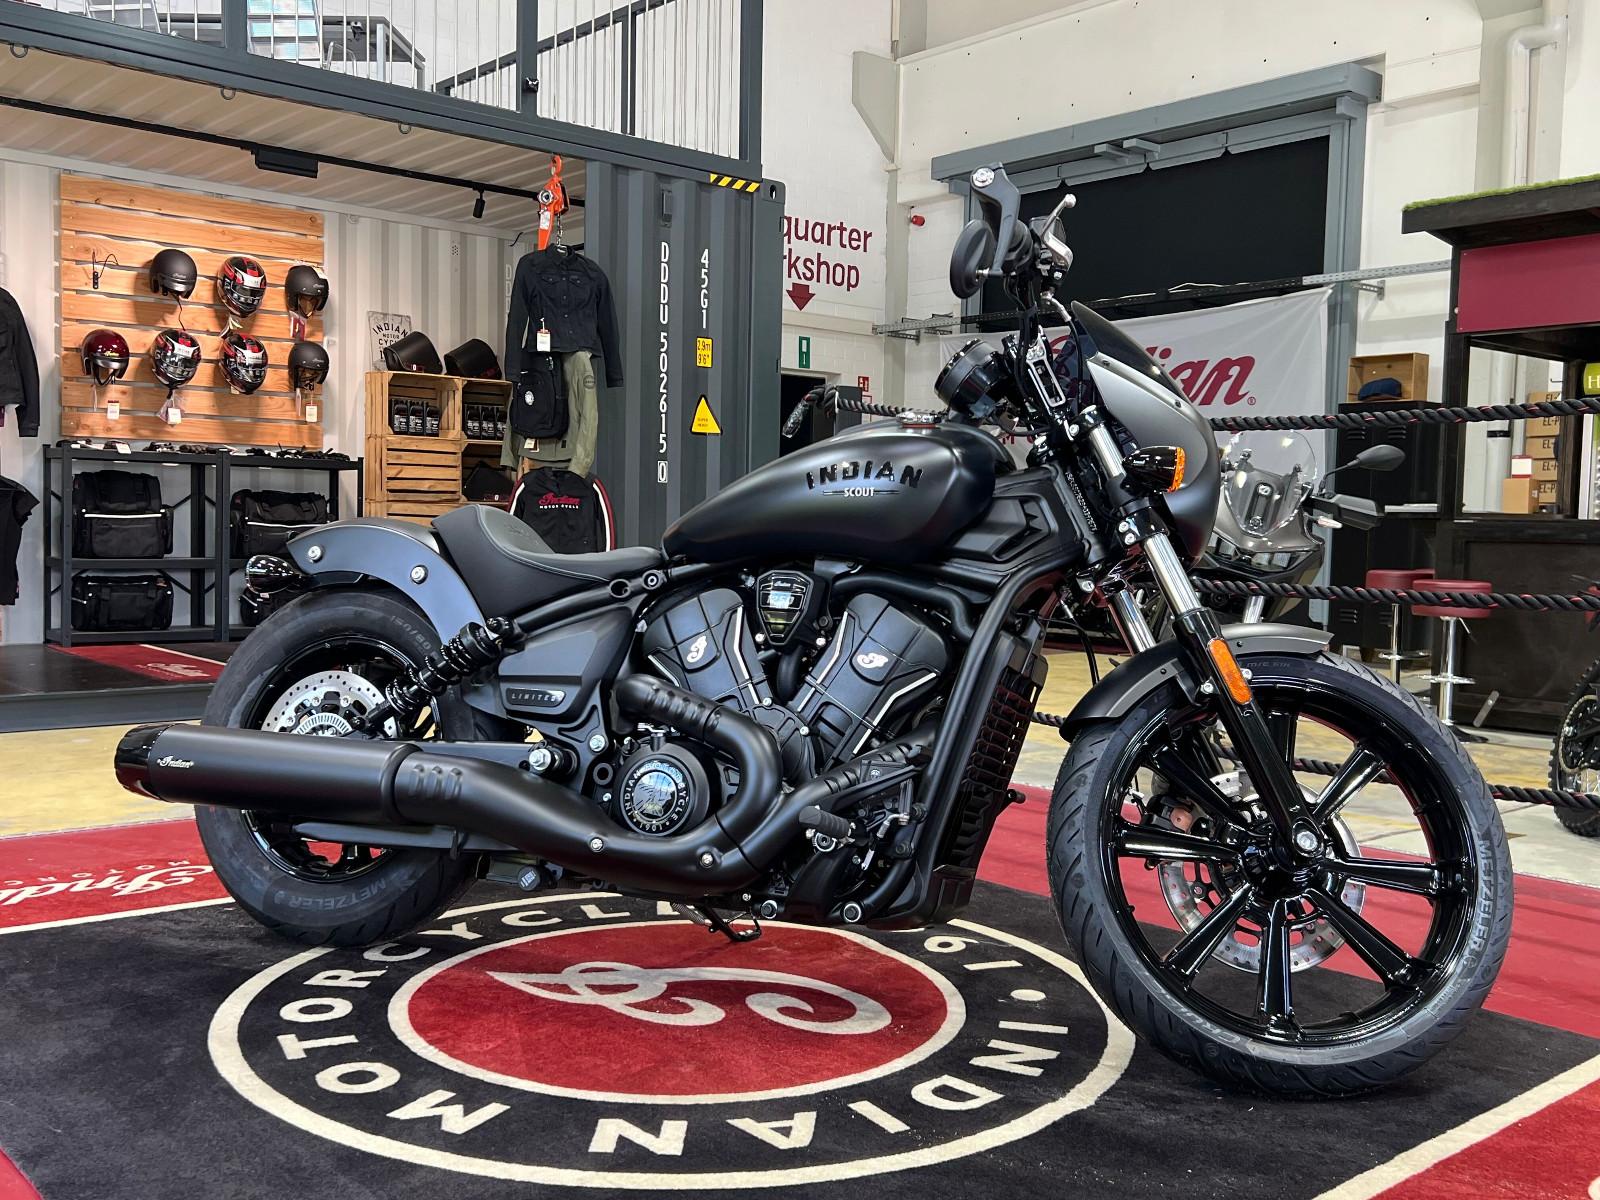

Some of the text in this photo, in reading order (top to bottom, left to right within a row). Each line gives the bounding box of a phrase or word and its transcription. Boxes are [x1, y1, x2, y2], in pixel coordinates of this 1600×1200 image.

[659, 241, 669, 324] DDDU
[700, 248, 709, 329] 45G1
[372, 322, 408, 338] INDIAN
[659, 332, 668, 453] 502615
[806, 460, 923, 490] INDIAN
[843, 486, 875, 498] SCOUT
[159, 755, 192, 769] Indian
[289, 879, 387, 910] METZELER
[1470, 840, 1495, 953] METZELER
[588, 1020, 1069, 1156] INDIAN
